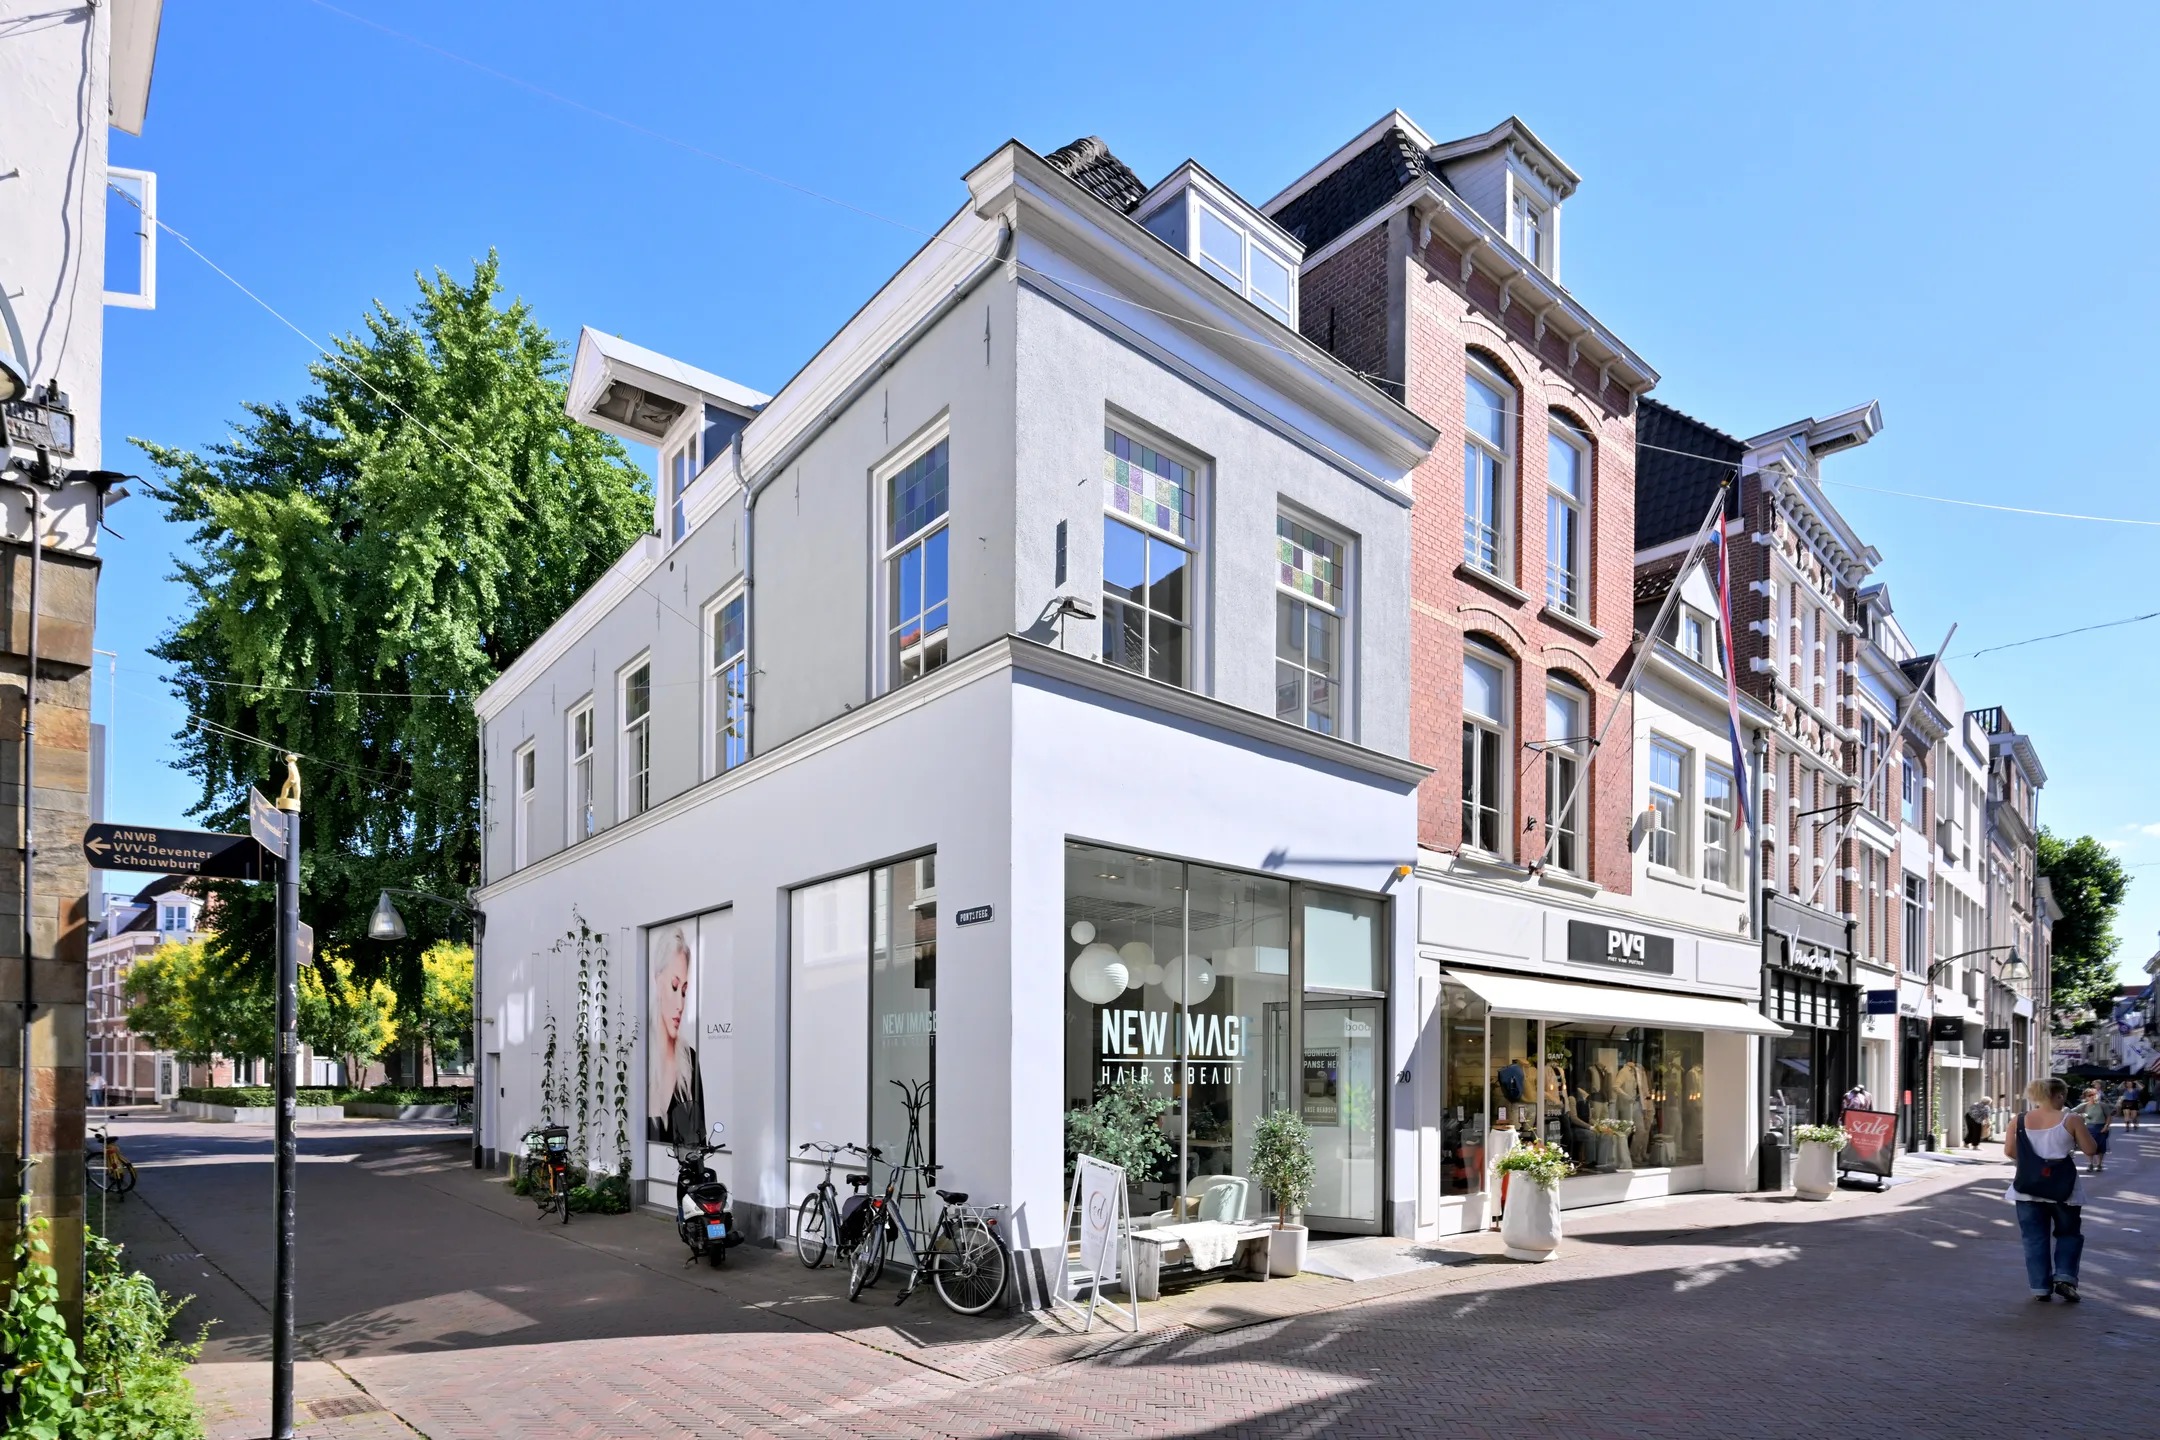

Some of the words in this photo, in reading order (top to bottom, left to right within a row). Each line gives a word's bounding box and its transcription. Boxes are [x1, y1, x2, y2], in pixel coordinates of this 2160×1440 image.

[113, 830, 156, 842] ANWB
[113, 842, 213, 859] VVV-Deventer
[113, 854, 201, 871] Schouwburg
[707, 1023, 733, 1034] LANZ
[882, 1012, 905, 1035] NEW
[1102, 1008, 1168, 1056] NEW
[1102, 1065, 1149, 1085] HAIR
[1164, 1066, 1174, 1085] &
[1850, 1116, 1890, 1136] sale
